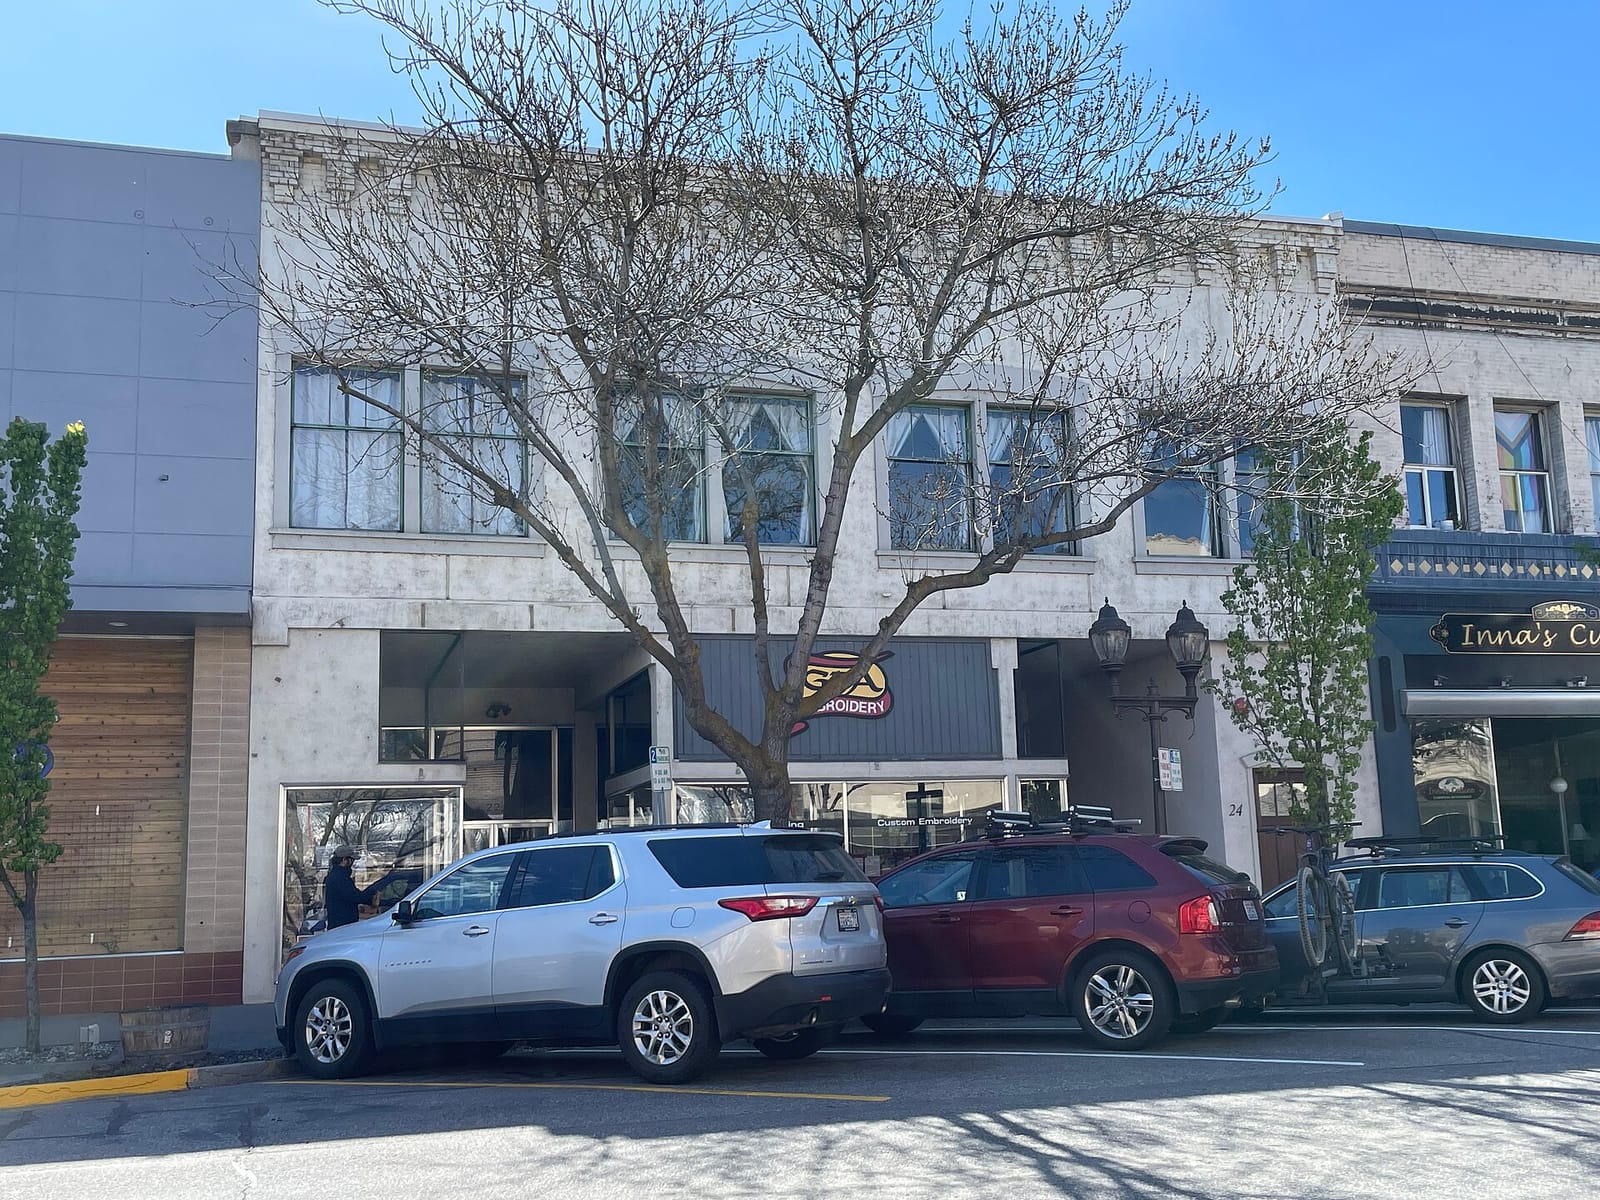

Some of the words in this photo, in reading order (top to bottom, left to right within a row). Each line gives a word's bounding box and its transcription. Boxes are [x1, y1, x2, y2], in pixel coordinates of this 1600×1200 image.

[1461, 622, 1557, 648] Inna's
[817, 699, 884, 714] ROIDERY
[1228, 804, 1243, 817] 24
[877, 819, 916, 827] Custom
[918, 817, 973, 826] Embroidery
